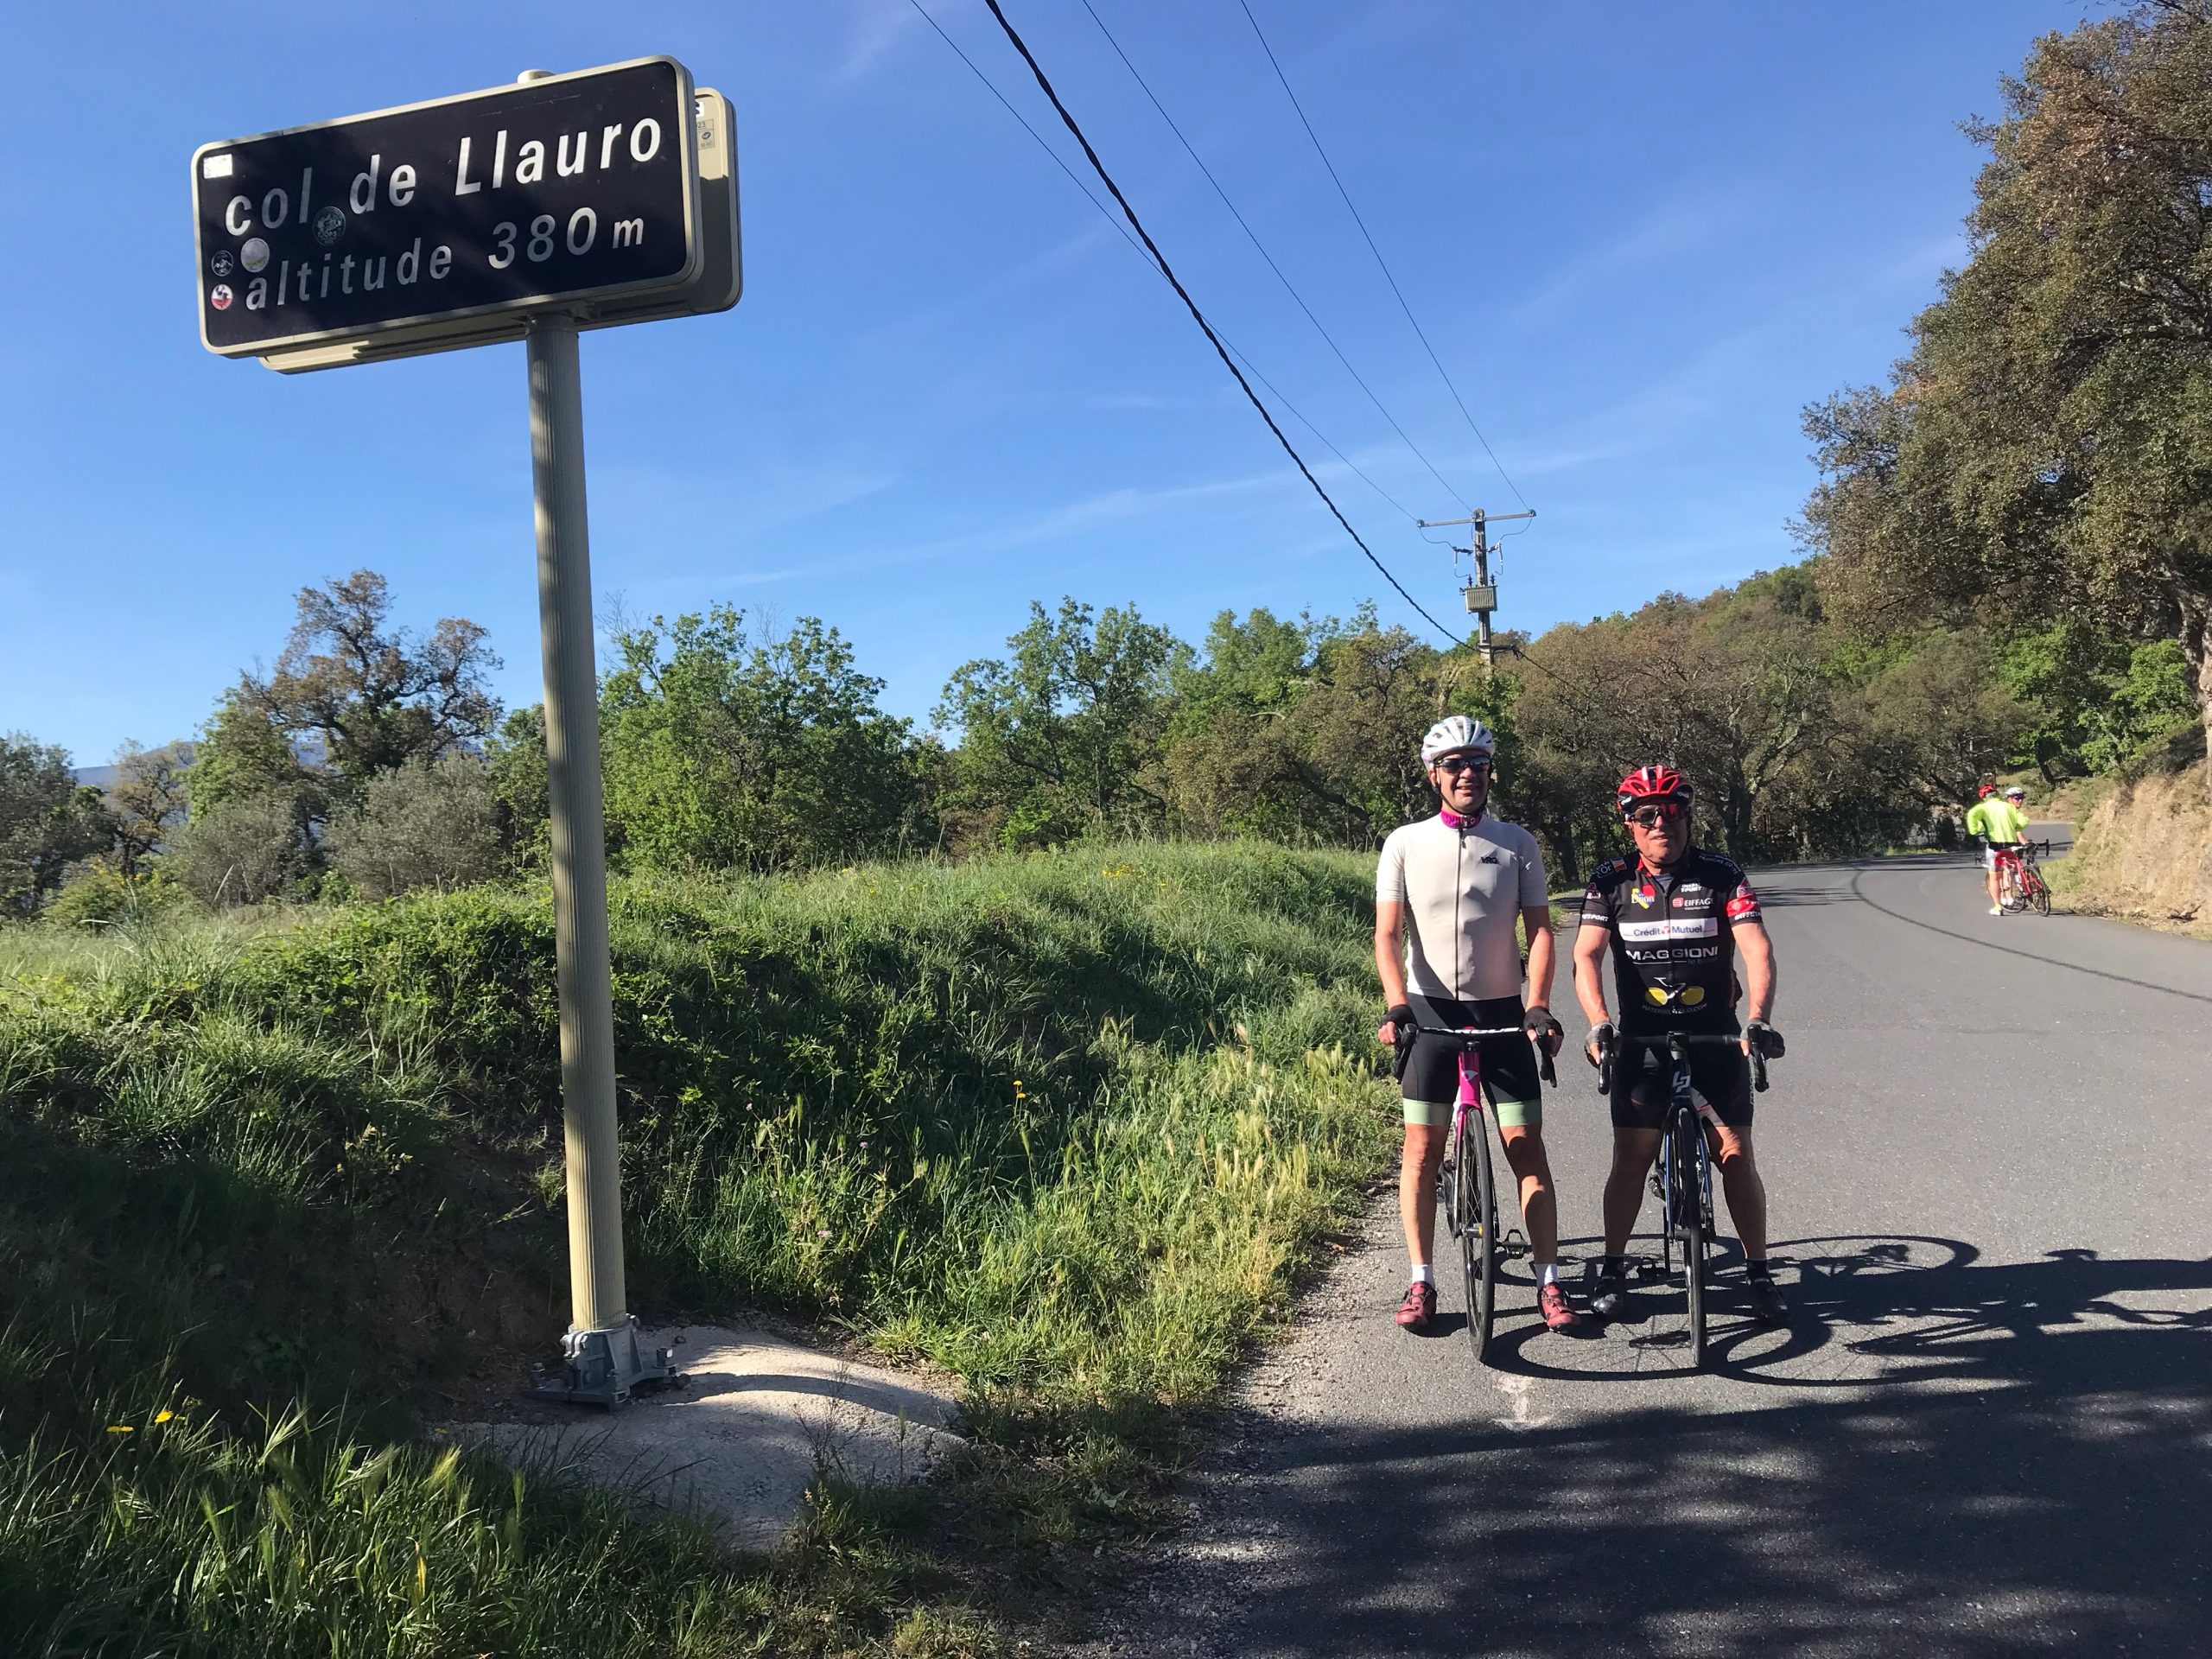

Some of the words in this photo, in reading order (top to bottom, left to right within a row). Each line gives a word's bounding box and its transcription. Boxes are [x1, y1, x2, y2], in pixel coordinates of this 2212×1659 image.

[225, 167, 311, 237] col
[349, 154, 416, 214] de
[454, 117, 661, 196] Llauro
[245, 237, 452, 312] altitude
[488, 207, 597, 270] 380
[612, 217, 645, 250] m
[1625, 945, 1719, 961] MAGGIONI
[1633, 927, 1661, 937] Crédit
[1671, 925, 1703, 934] Mutuel
